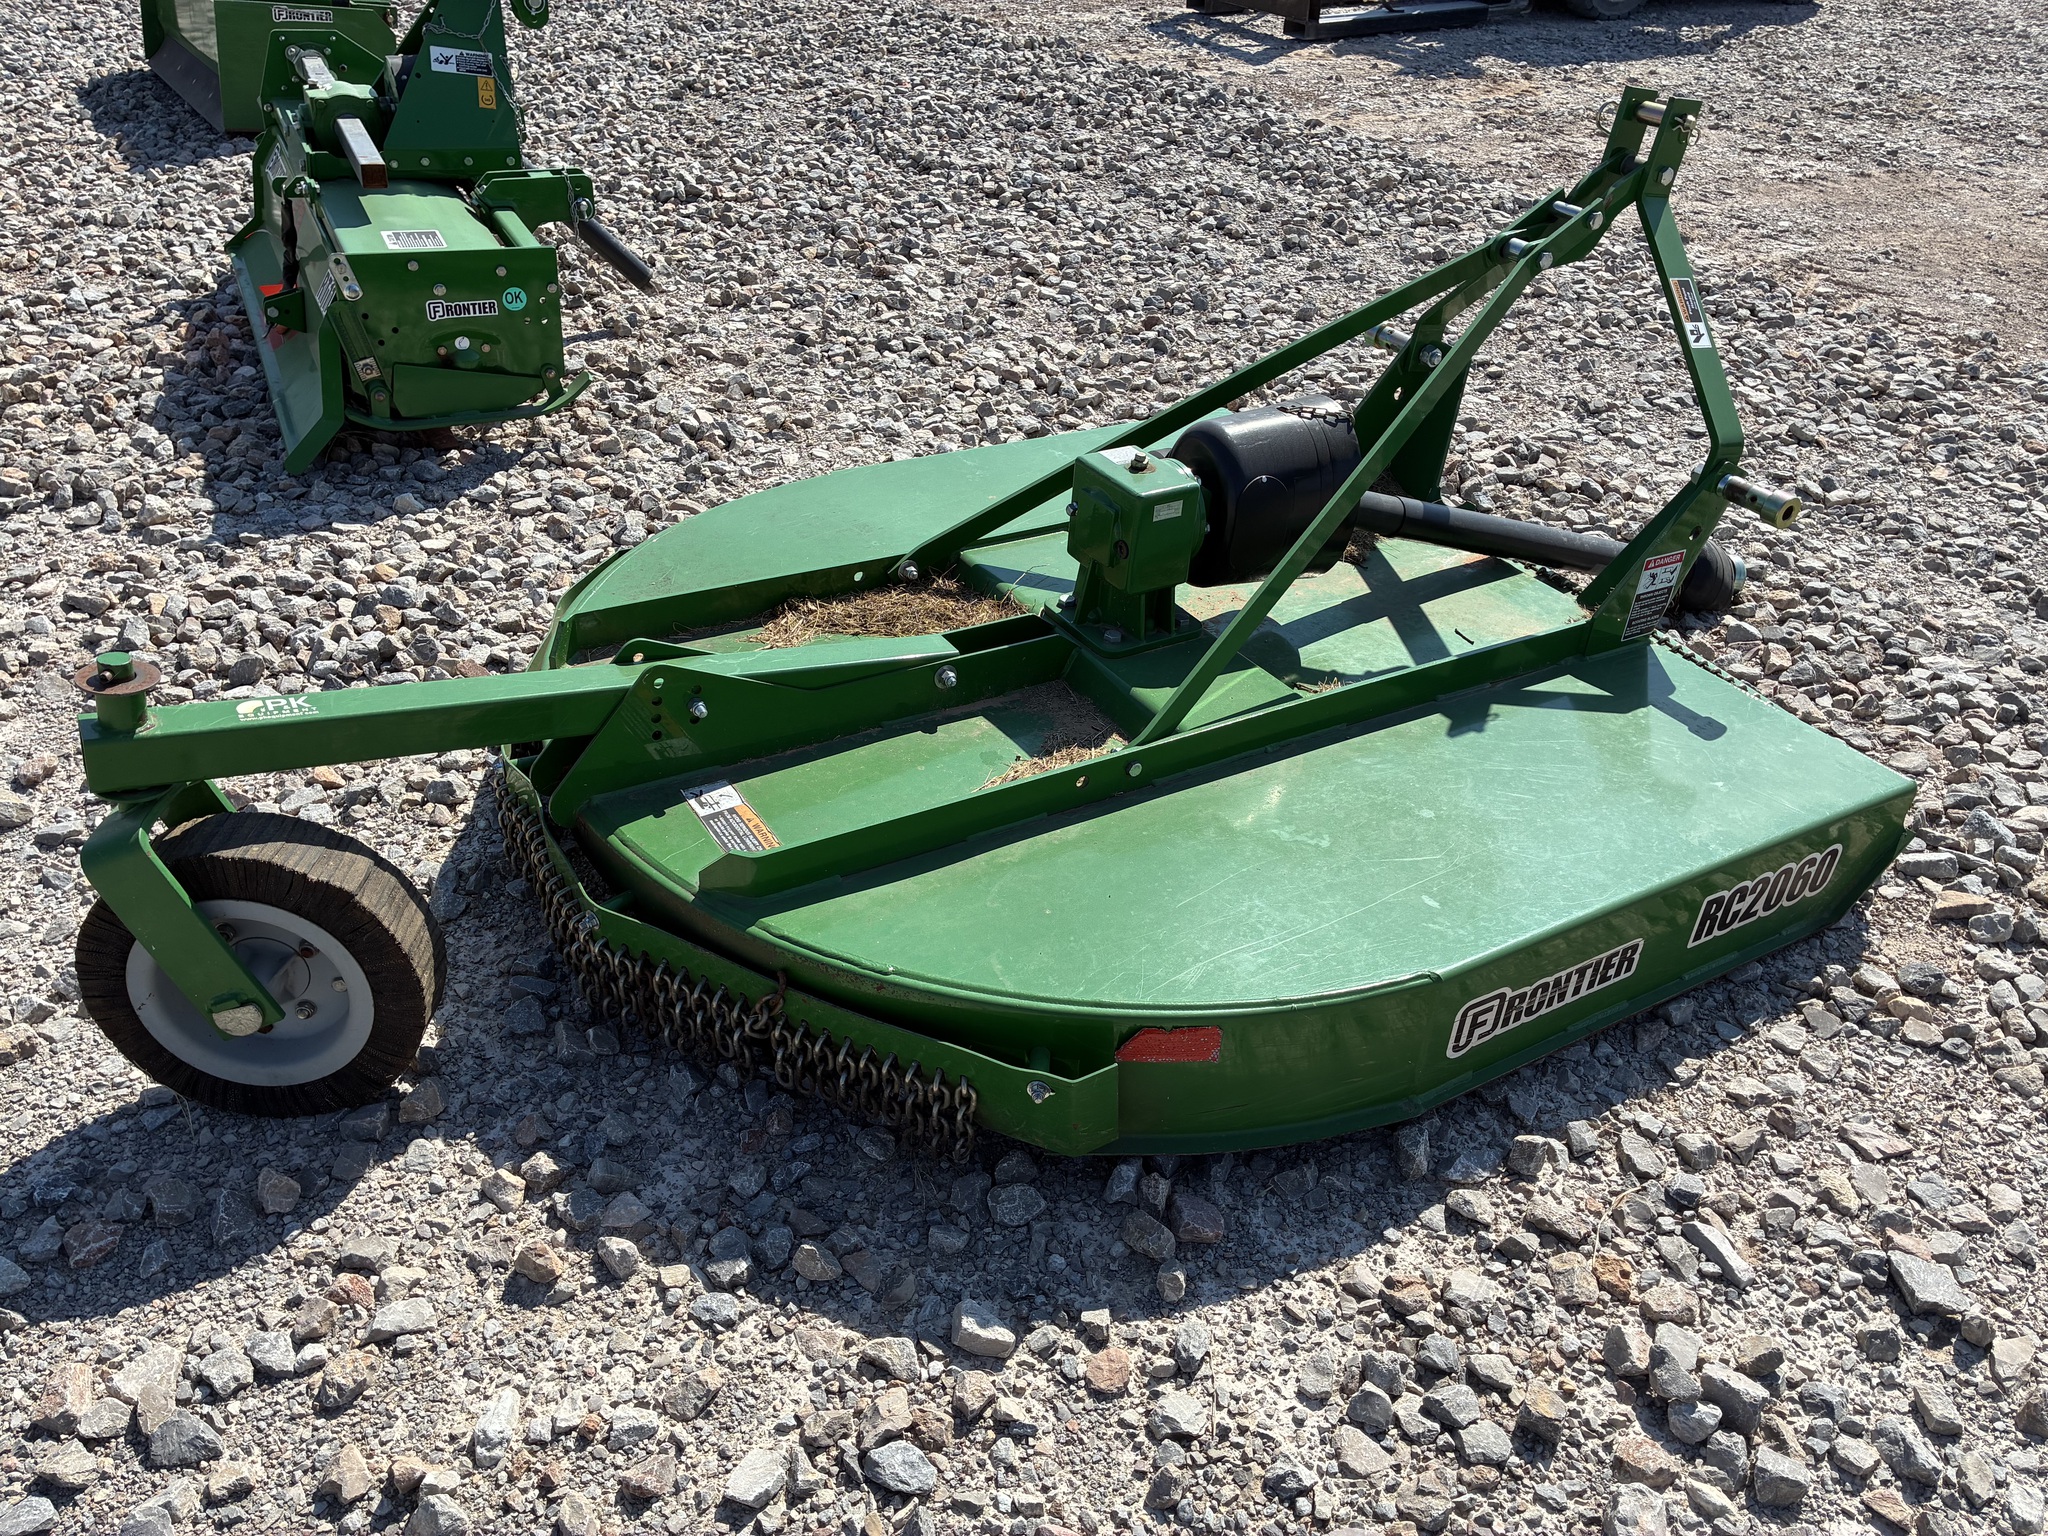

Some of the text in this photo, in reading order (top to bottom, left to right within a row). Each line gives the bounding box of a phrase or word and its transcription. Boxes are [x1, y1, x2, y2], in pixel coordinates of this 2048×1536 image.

[273, 6, 332, 22] FRONTIER
[504, 289, 523, 304] OK
[427, 301, 497, 320] FRONTIER
[1654, 553, 1682, 566] DANGER
[238, 706, 317, 718] EQUIPMENT
[752, 823, 776, 848] WARNIN
[1691, 847, 1840, 944] RC2060
[1451, 942, 1640, 1053] FRONTIER
